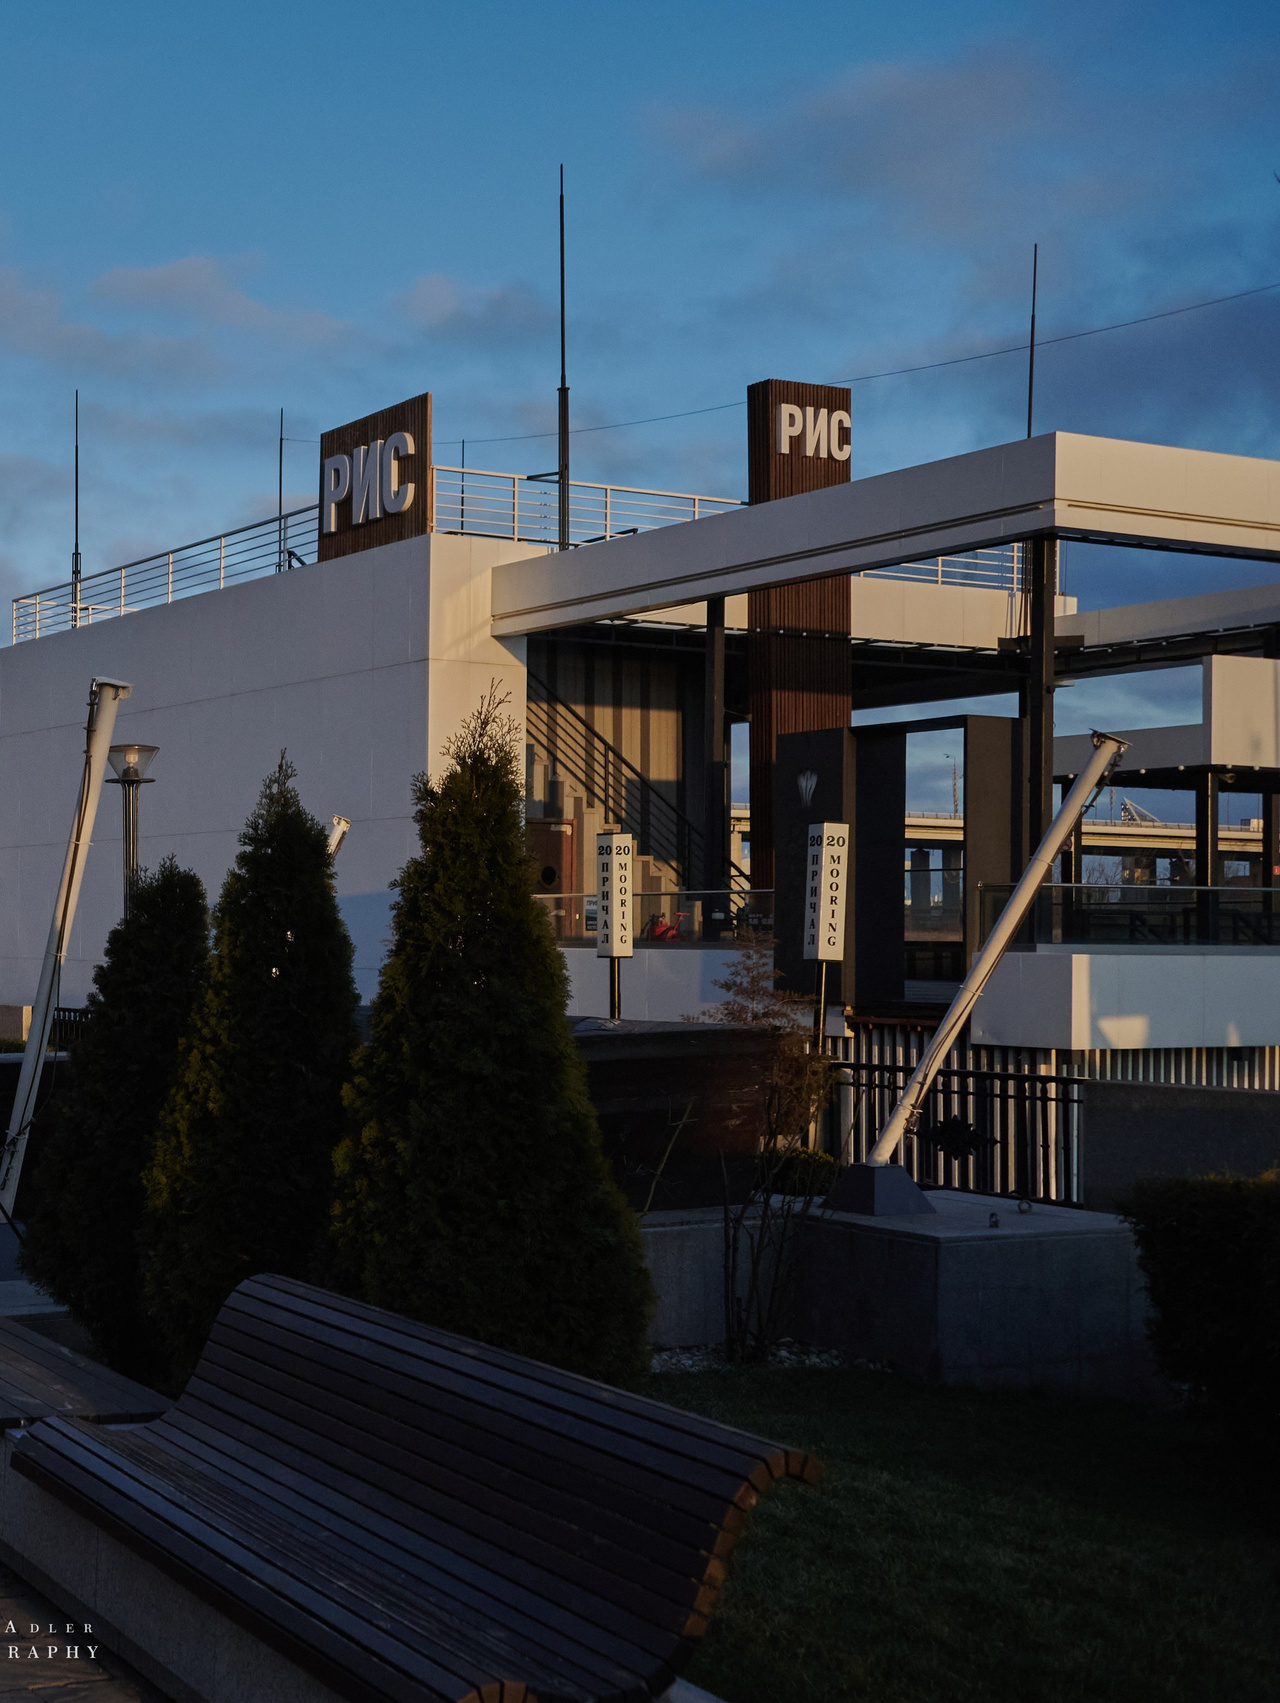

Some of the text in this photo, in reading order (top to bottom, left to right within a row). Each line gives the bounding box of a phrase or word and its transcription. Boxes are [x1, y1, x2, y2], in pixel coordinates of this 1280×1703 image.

[323, 431, 416, 534] РИС
[776, 402, 852, 462] РИС
[598, 845, 612, 944] 20 ПРИЧАЛ
[615, 845, 630, 944] 20 MOORING
[808, 835, 822, 945] 20 ПРИЧАЛ
[826, 835, 845, 946] 20 MOORING
